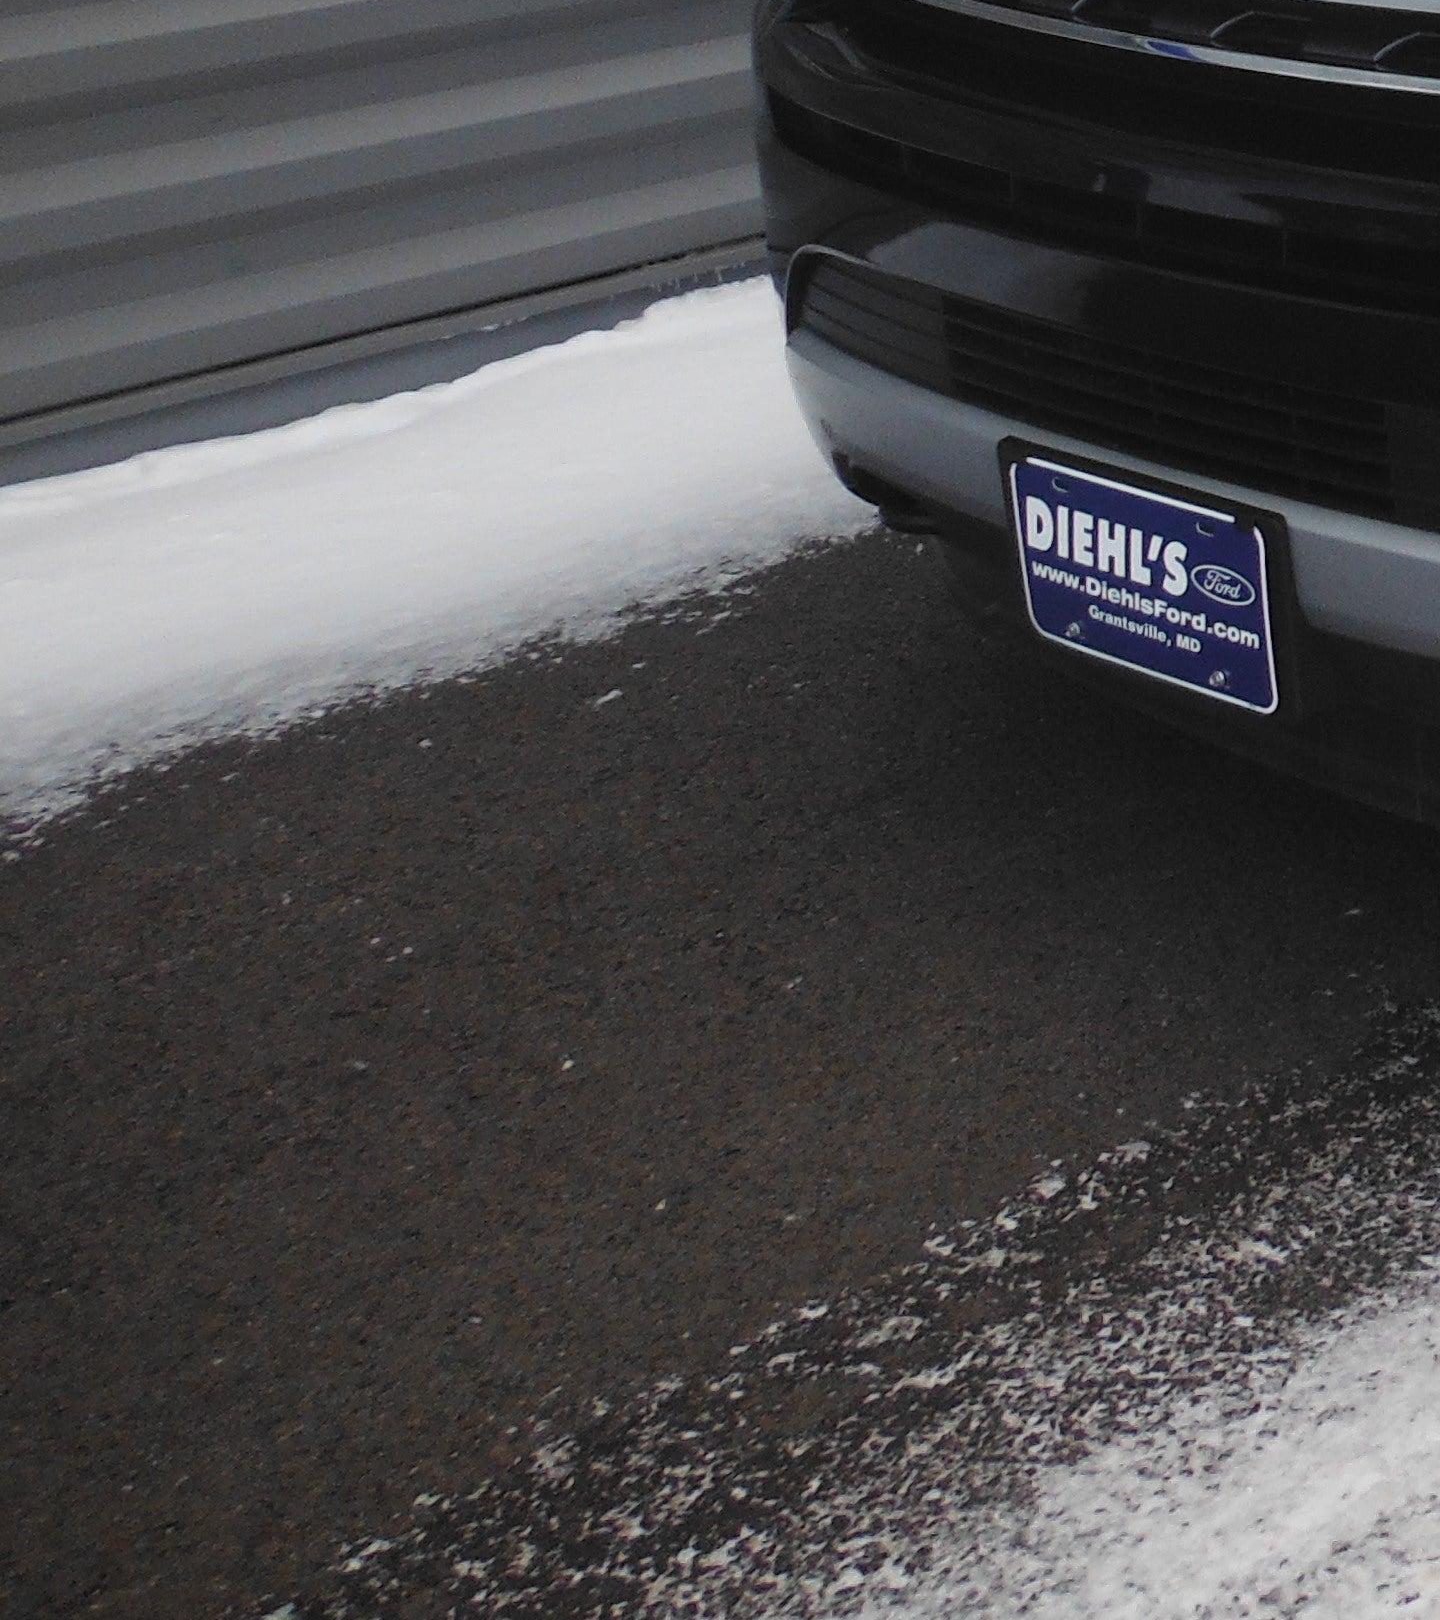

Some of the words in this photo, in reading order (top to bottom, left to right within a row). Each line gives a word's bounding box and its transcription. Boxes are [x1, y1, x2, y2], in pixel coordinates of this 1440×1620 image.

[1025, 495, 1188, 595] DIEHL'S
[1032, 561, 1260, 649] www.DiehlsFord.com
[1203, 571, 1241, 599] Ford
[1088, 604, 1172, 647] Grantsville,
[1175, 633, 1202, 653] MD
